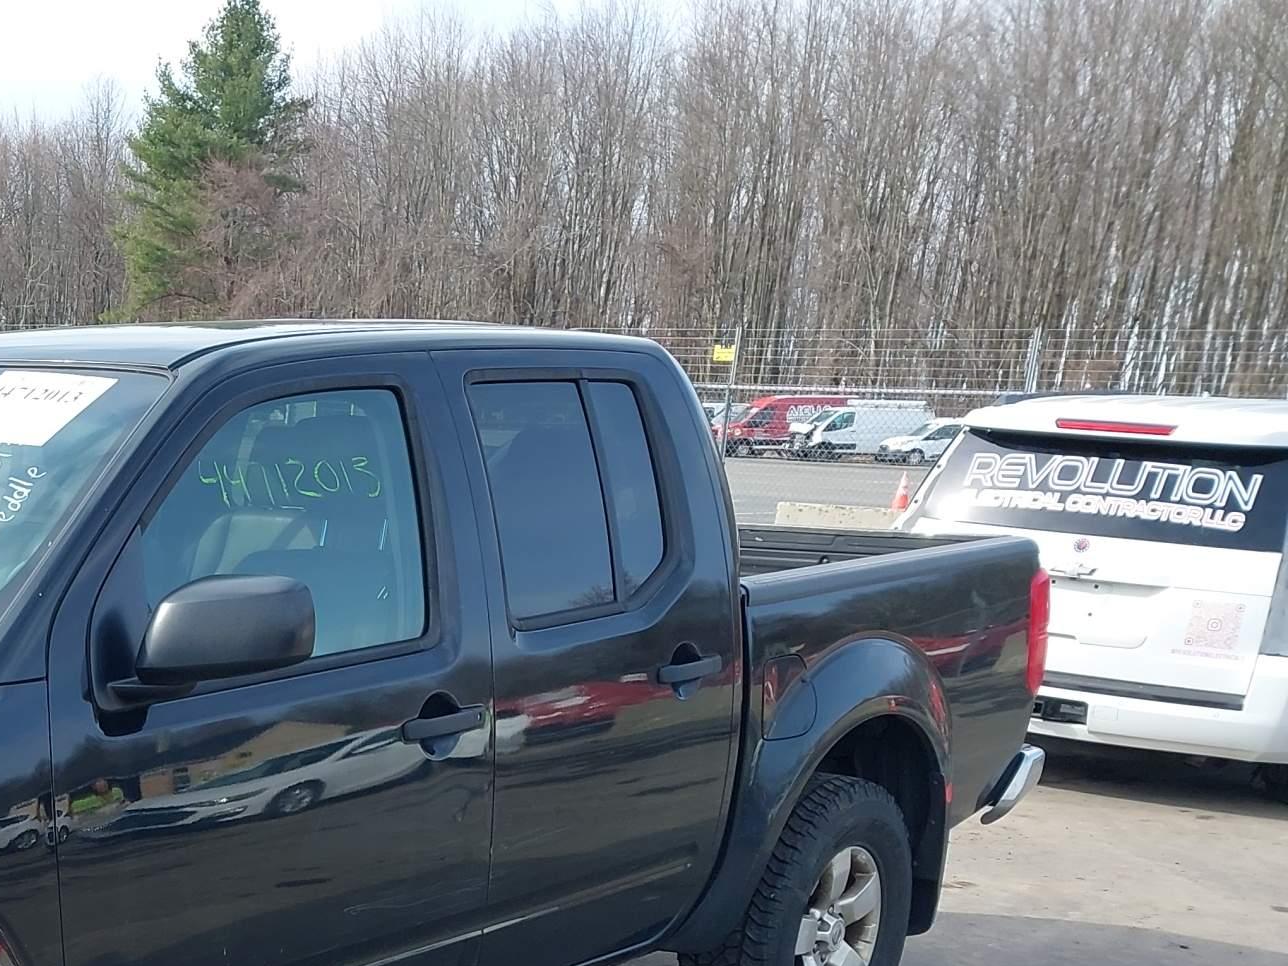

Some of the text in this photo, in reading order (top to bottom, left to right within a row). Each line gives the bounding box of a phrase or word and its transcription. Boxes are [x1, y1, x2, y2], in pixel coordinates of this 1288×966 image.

[198, 457, 381, 508] 44712013
[963, 453, 1263, 511] REVOLUTION
[1065, 493, 1204, 526] CONTRACTOR
[1202, 508, 1246, 532] LLC
